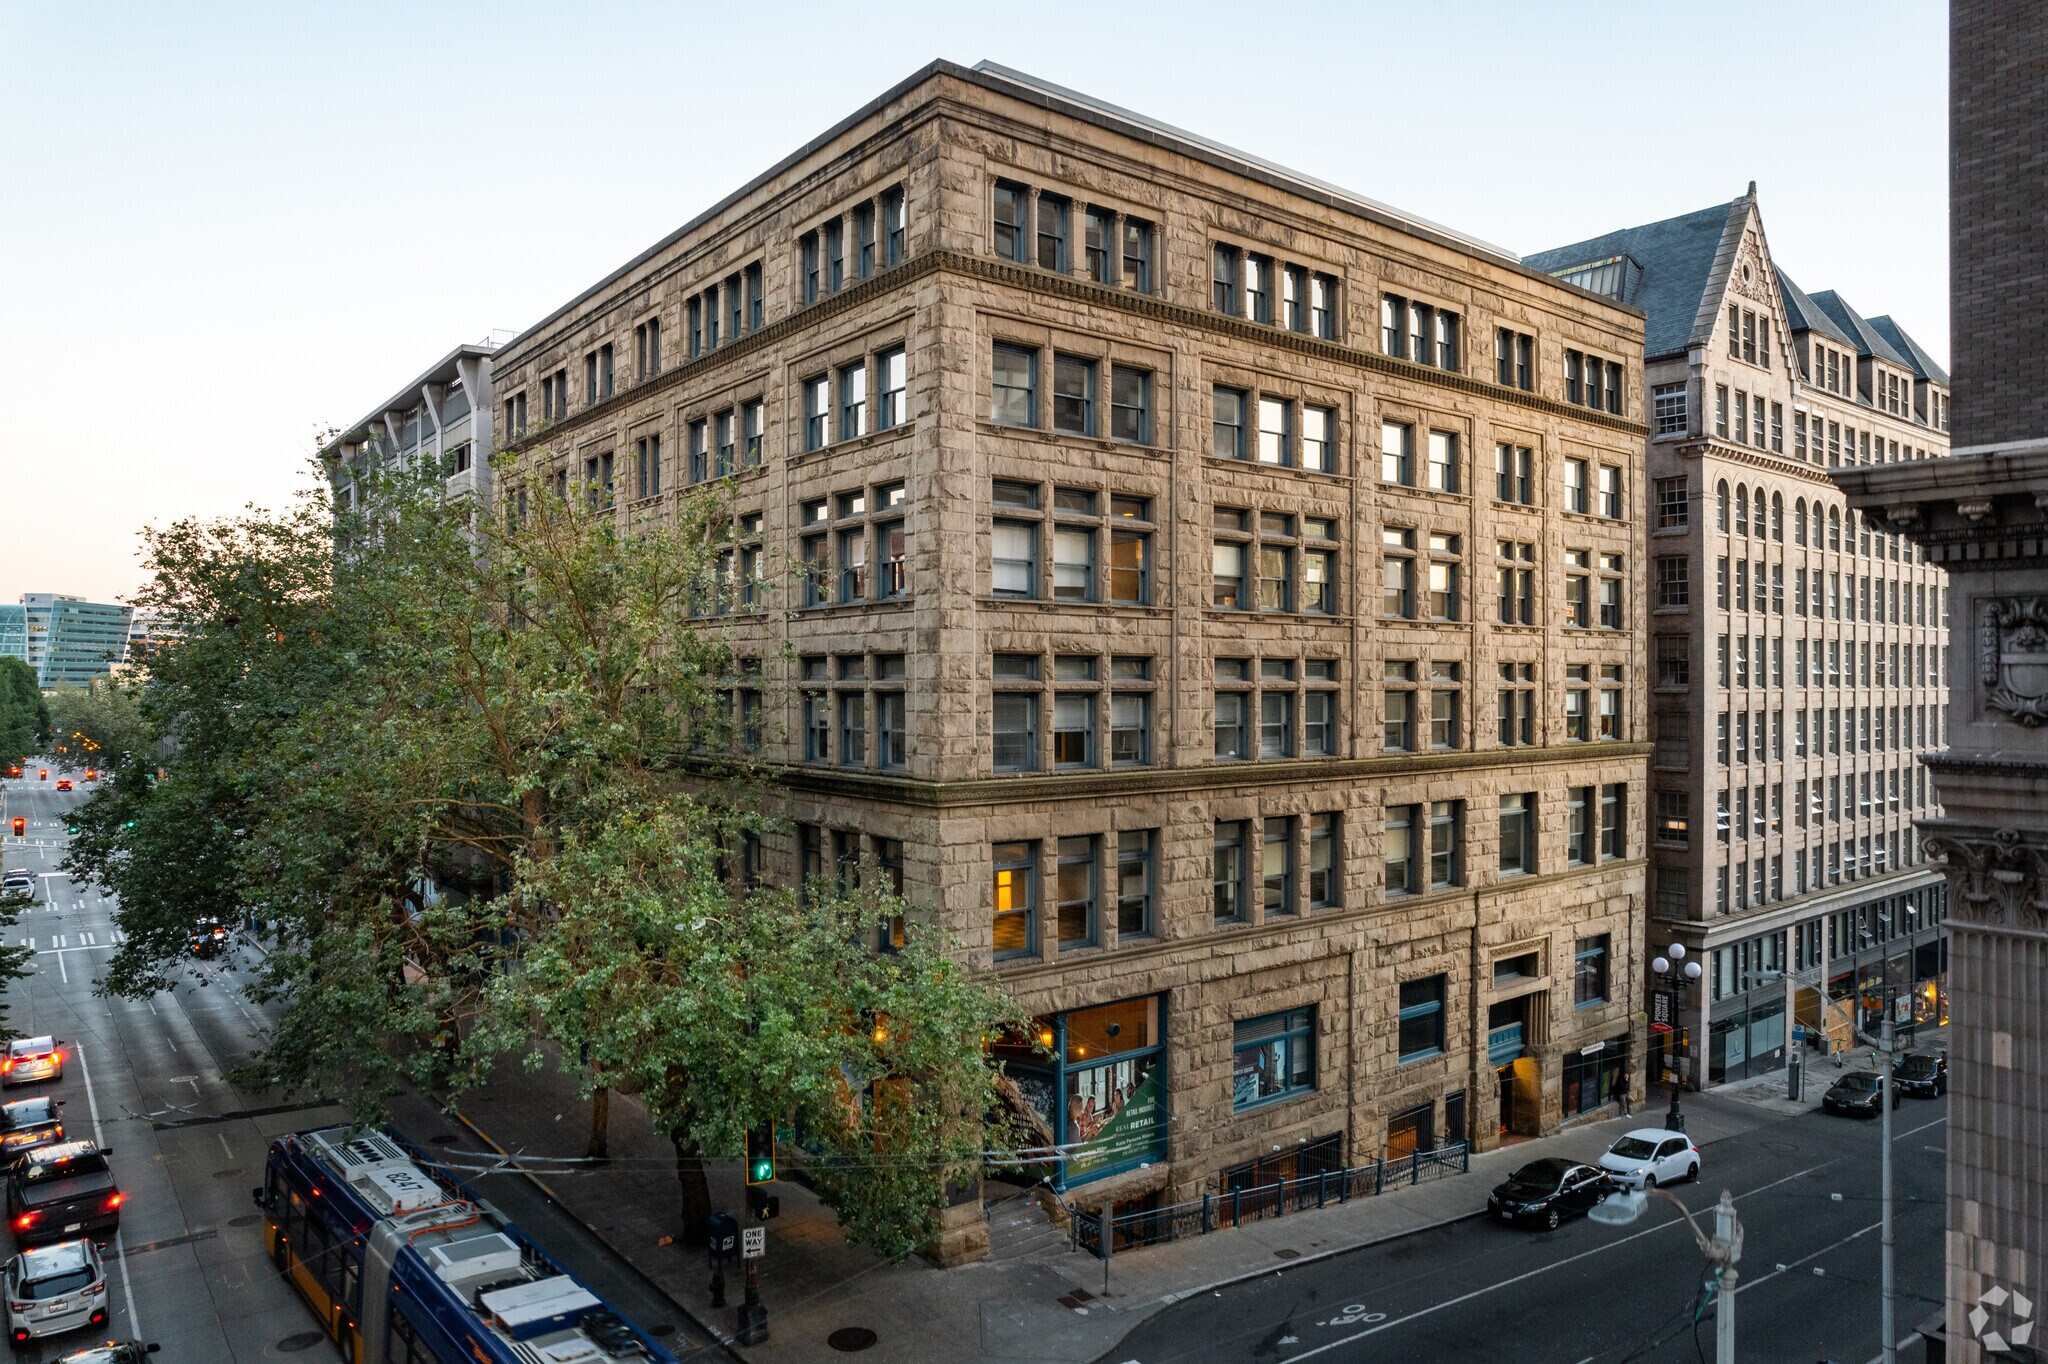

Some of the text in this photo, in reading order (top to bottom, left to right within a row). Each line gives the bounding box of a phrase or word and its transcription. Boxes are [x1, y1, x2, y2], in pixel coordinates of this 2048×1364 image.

[1126, 1108, 1138, 1117] RETAIL
[386, 1172, 424, 1191] 8247
[745, 1229, 762, 1238] ONE
[745, 1238, 762, 1247] WAY
